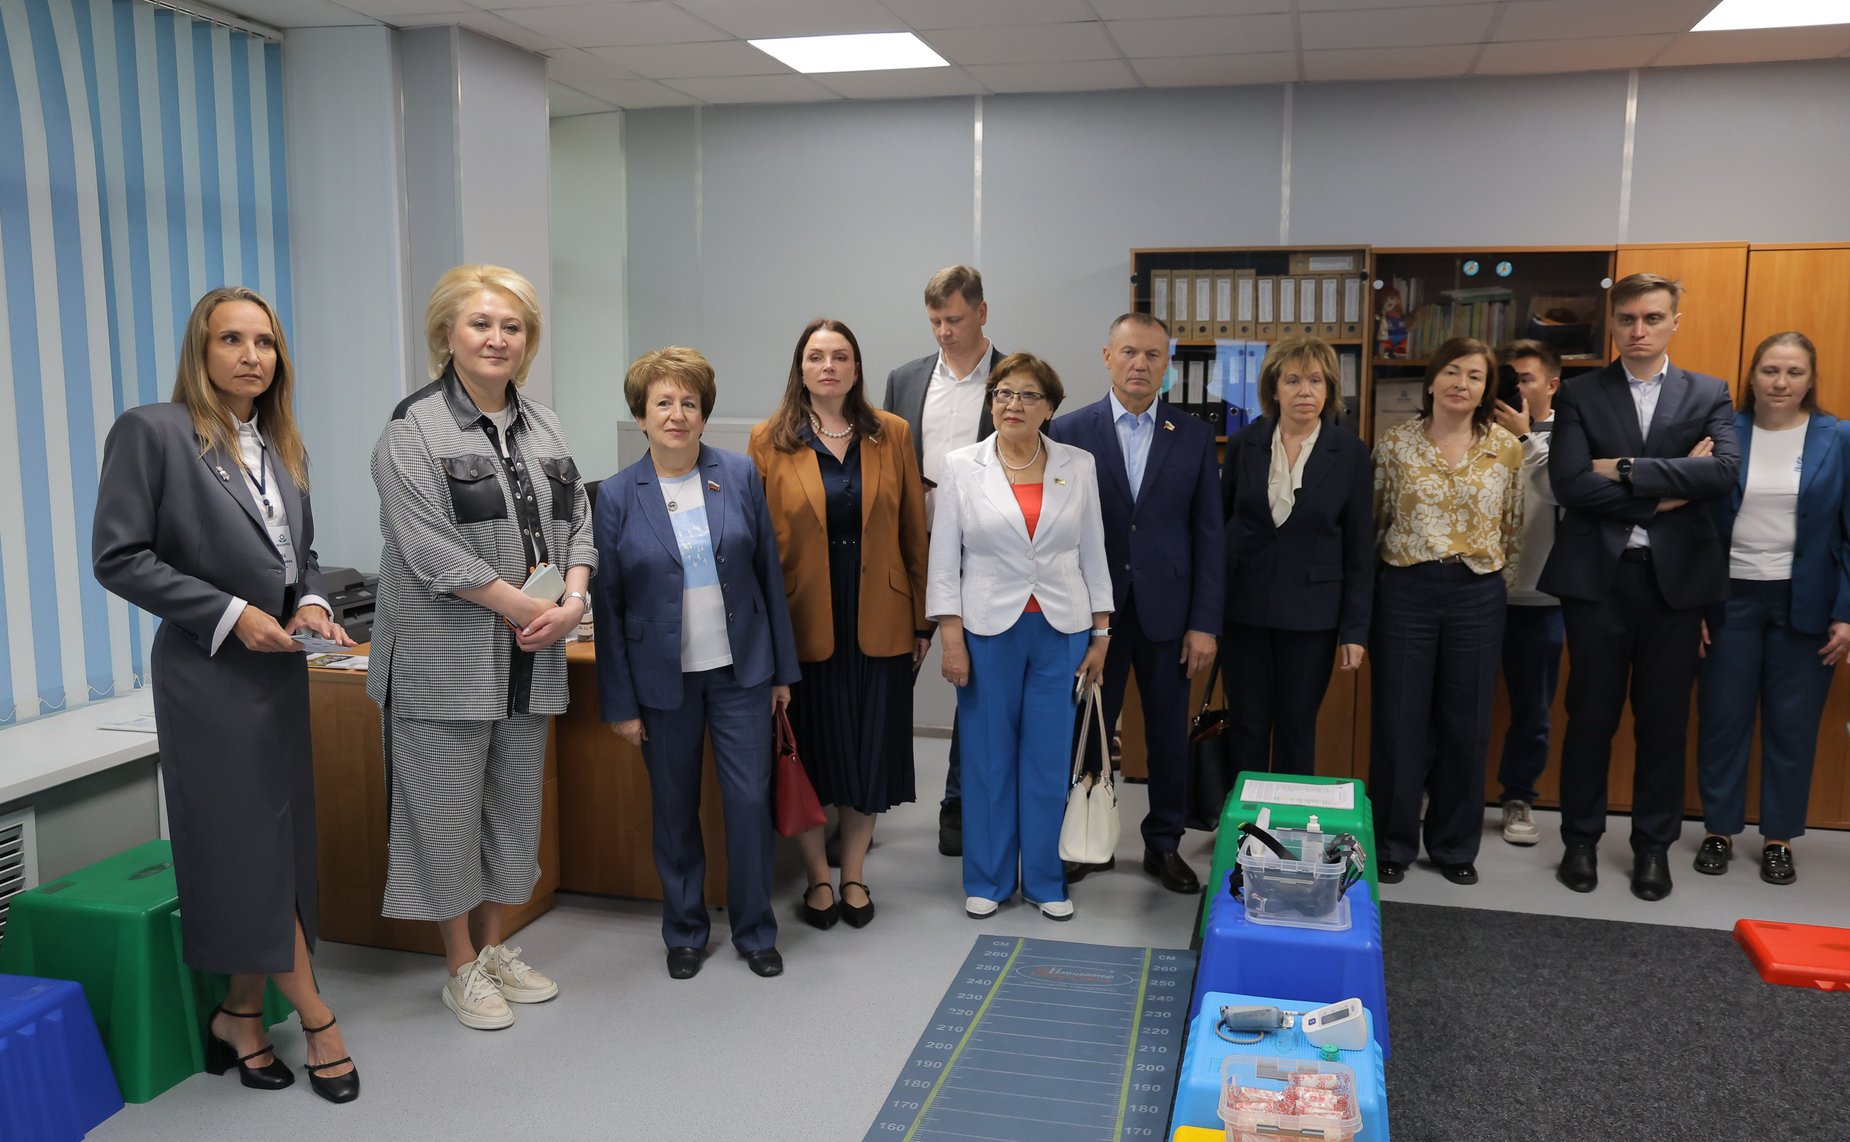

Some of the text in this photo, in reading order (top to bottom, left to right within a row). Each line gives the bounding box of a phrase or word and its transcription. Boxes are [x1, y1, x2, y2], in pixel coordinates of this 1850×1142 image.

[984, 950, 1009, 958] 260
[976, 964, 1001, 972] 250
[966, 978, 992, 986] 240
[1149, 979, 1177, 987] 250
[957, 993, 983, 1001] 230
[1147, 994, 1175, 1002] 240
[948, 1007, 974, 1016] 220
[1144, 1010, 1173, 1019] 230
[936, 1024, 964, 1033] 210
[1142, 1028, 1171, 1036] 220
[925, 1041, 954, 1050] 200
[1138, 1045, 1168, 1054] 210
[915, 1060, 943, 1069] 190
[1135, 1063, 1166, 1072] 200
[903, 1078, 931, 1089] 180
[1132, 1082, 1161, 1092] 190
[894, 1100, 919, 1110] 170
[1128, 1105, 1160, 1114] 180
[879, 1121, 906, 1132] 160
[1123, 1126, 1153, 1136] 170
